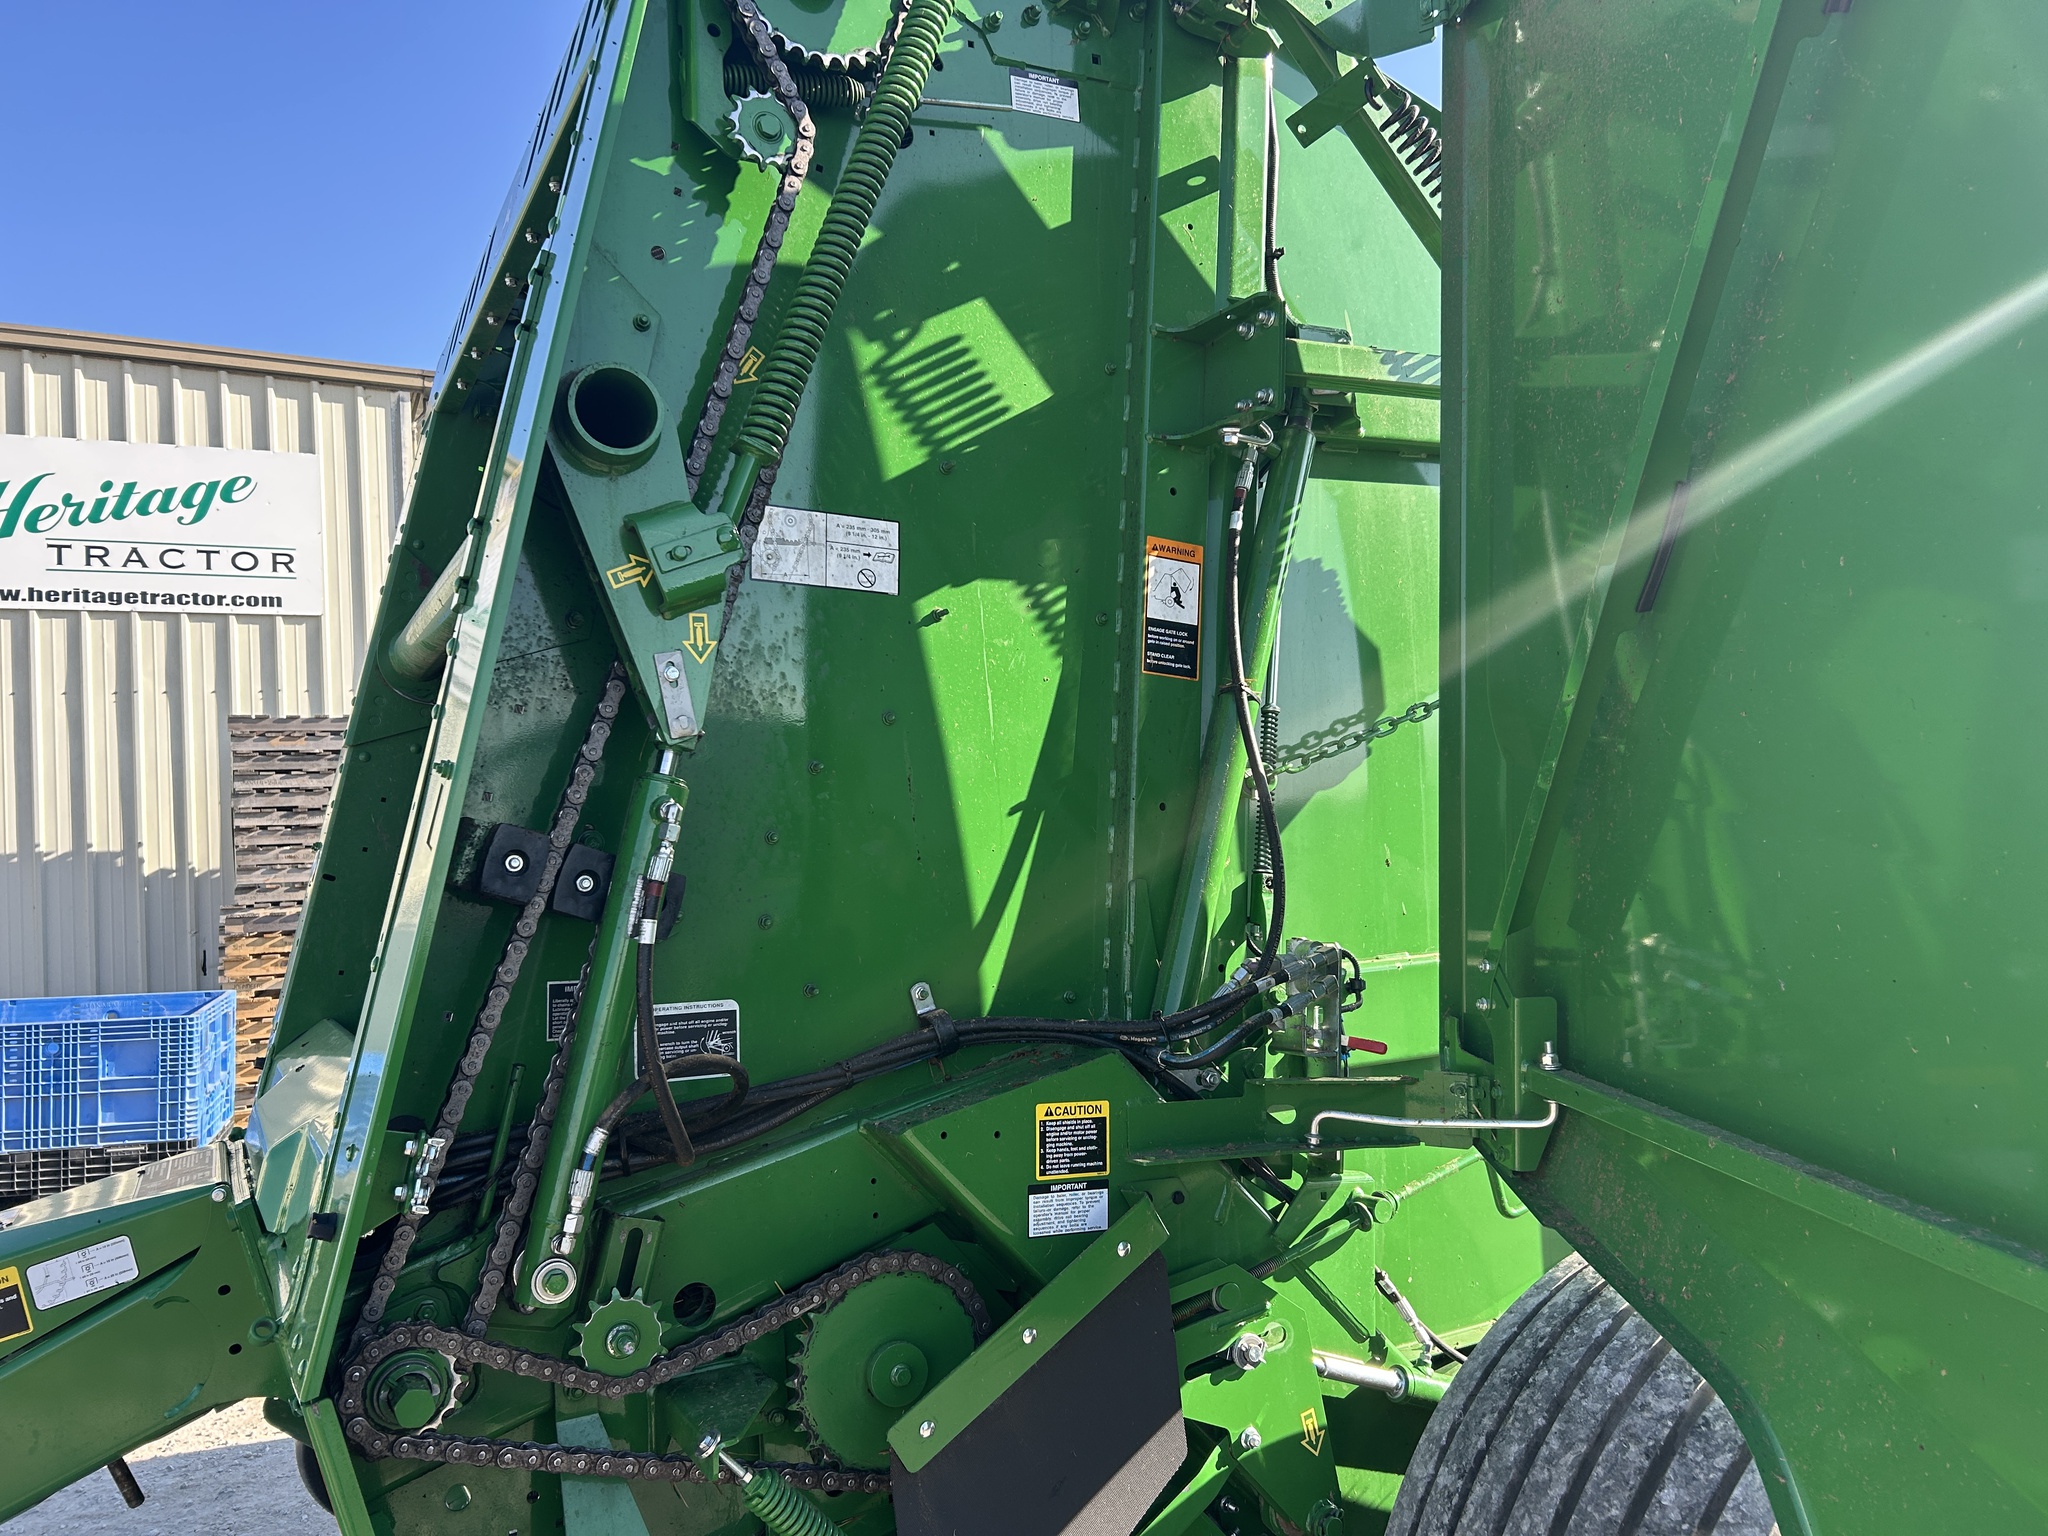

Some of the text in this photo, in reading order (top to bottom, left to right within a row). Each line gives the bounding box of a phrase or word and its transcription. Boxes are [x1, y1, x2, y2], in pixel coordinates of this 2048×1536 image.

[1028, 73, 1060, 83] IMPORTANT
[0, 472, 258, 540] Heritage
[1159, 544, 1196, 558] WARNING
[46, 544, 296, 574] TRACTOR
[1054, 1105, 1102, 1116] CAUTION
[1051, 1183, 1087, 1191] IMPORTANT
